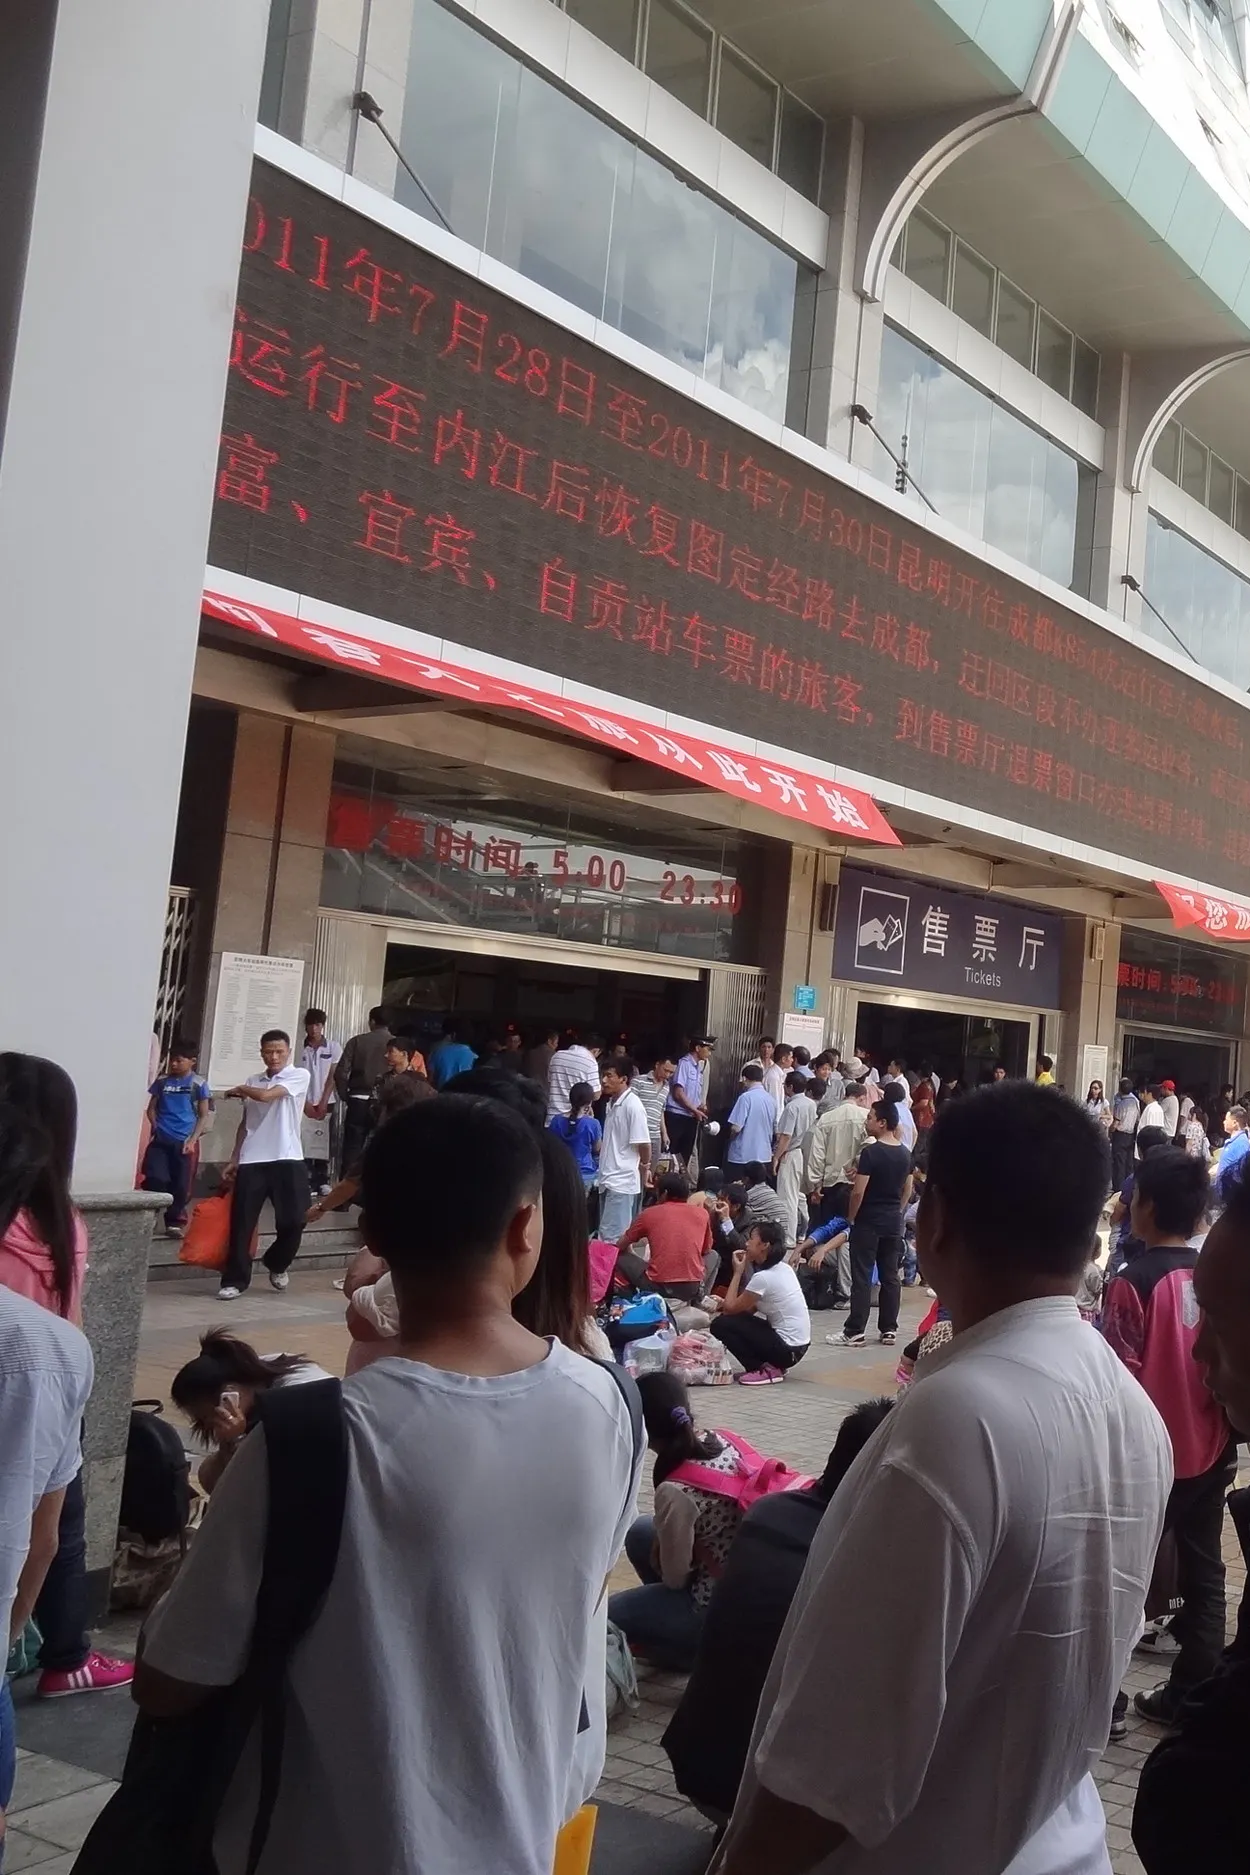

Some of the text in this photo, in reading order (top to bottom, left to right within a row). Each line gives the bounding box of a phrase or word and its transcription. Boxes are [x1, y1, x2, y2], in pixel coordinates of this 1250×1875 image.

[921, 905, 1045, 970] 售票厅
[965, 967, 1001, 987] Tickets
